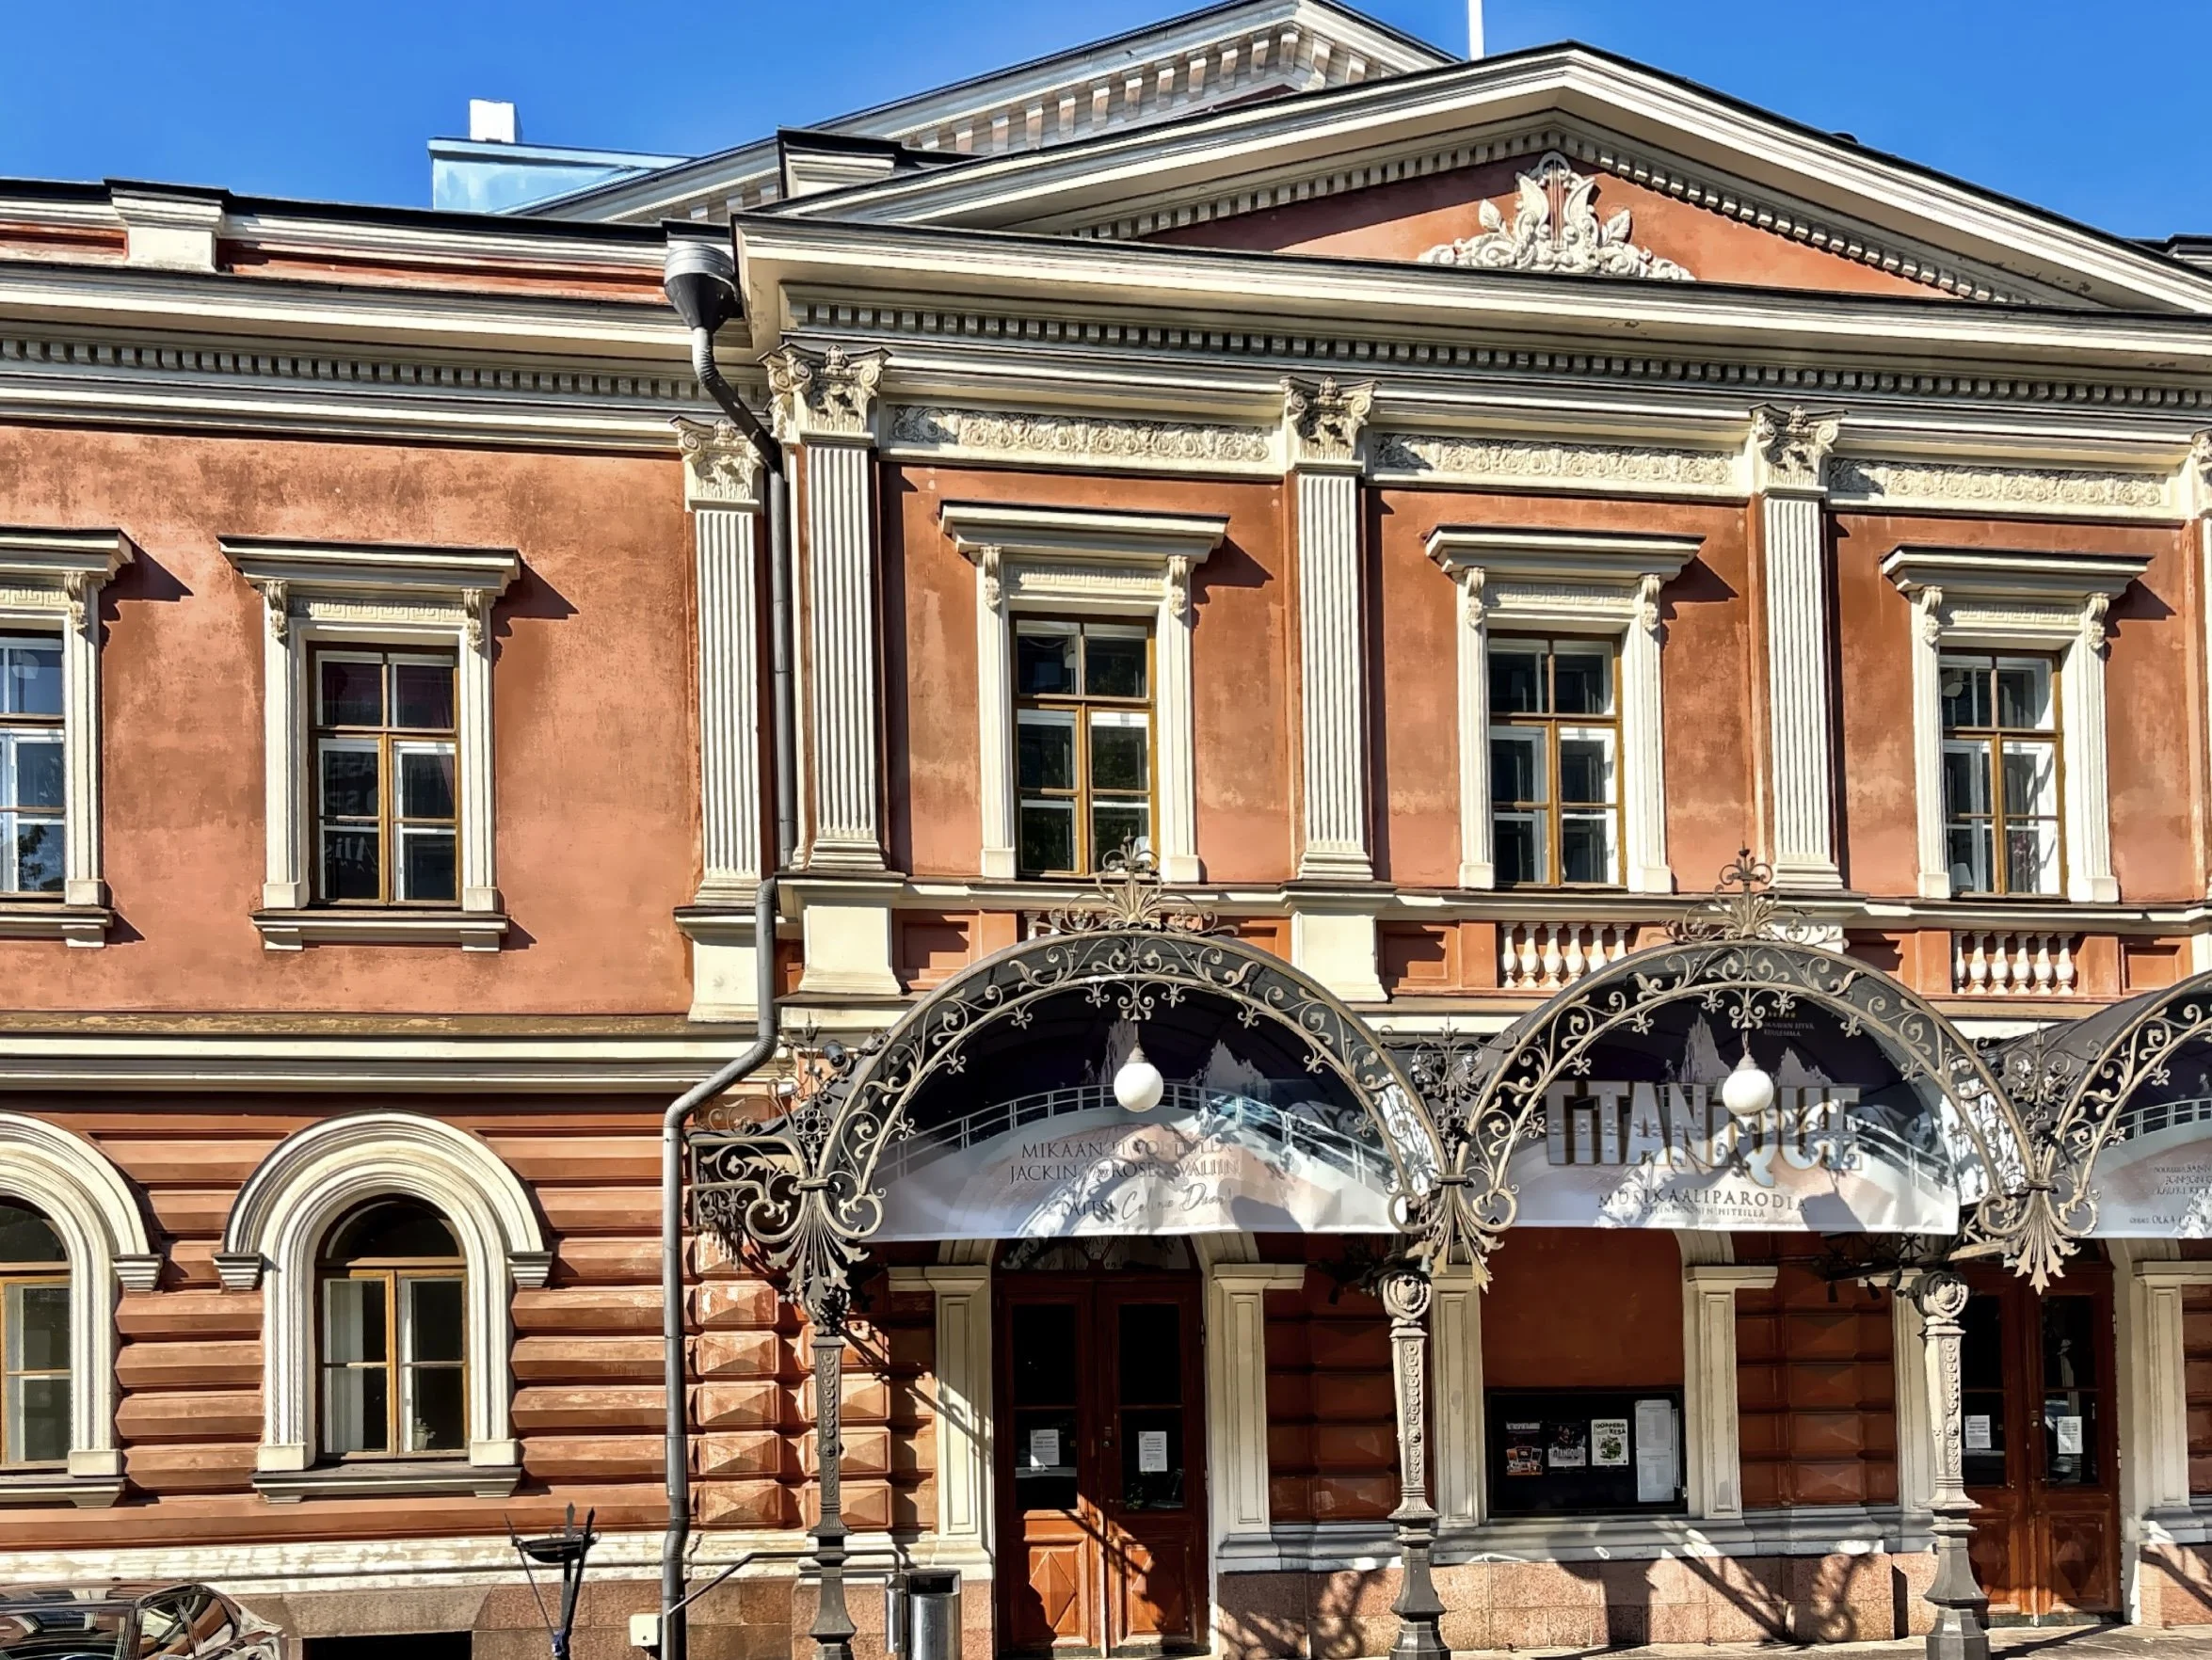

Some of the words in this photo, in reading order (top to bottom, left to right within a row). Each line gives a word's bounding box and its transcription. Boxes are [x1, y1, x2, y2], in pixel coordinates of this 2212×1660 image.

[1021, 1139, 1103, 1159] MIKÄÄN
[1009, 1164, 1077, 1185] JACKIN
[1597, 1188, 1808, 1213] MUSIKAALIPARODIA
